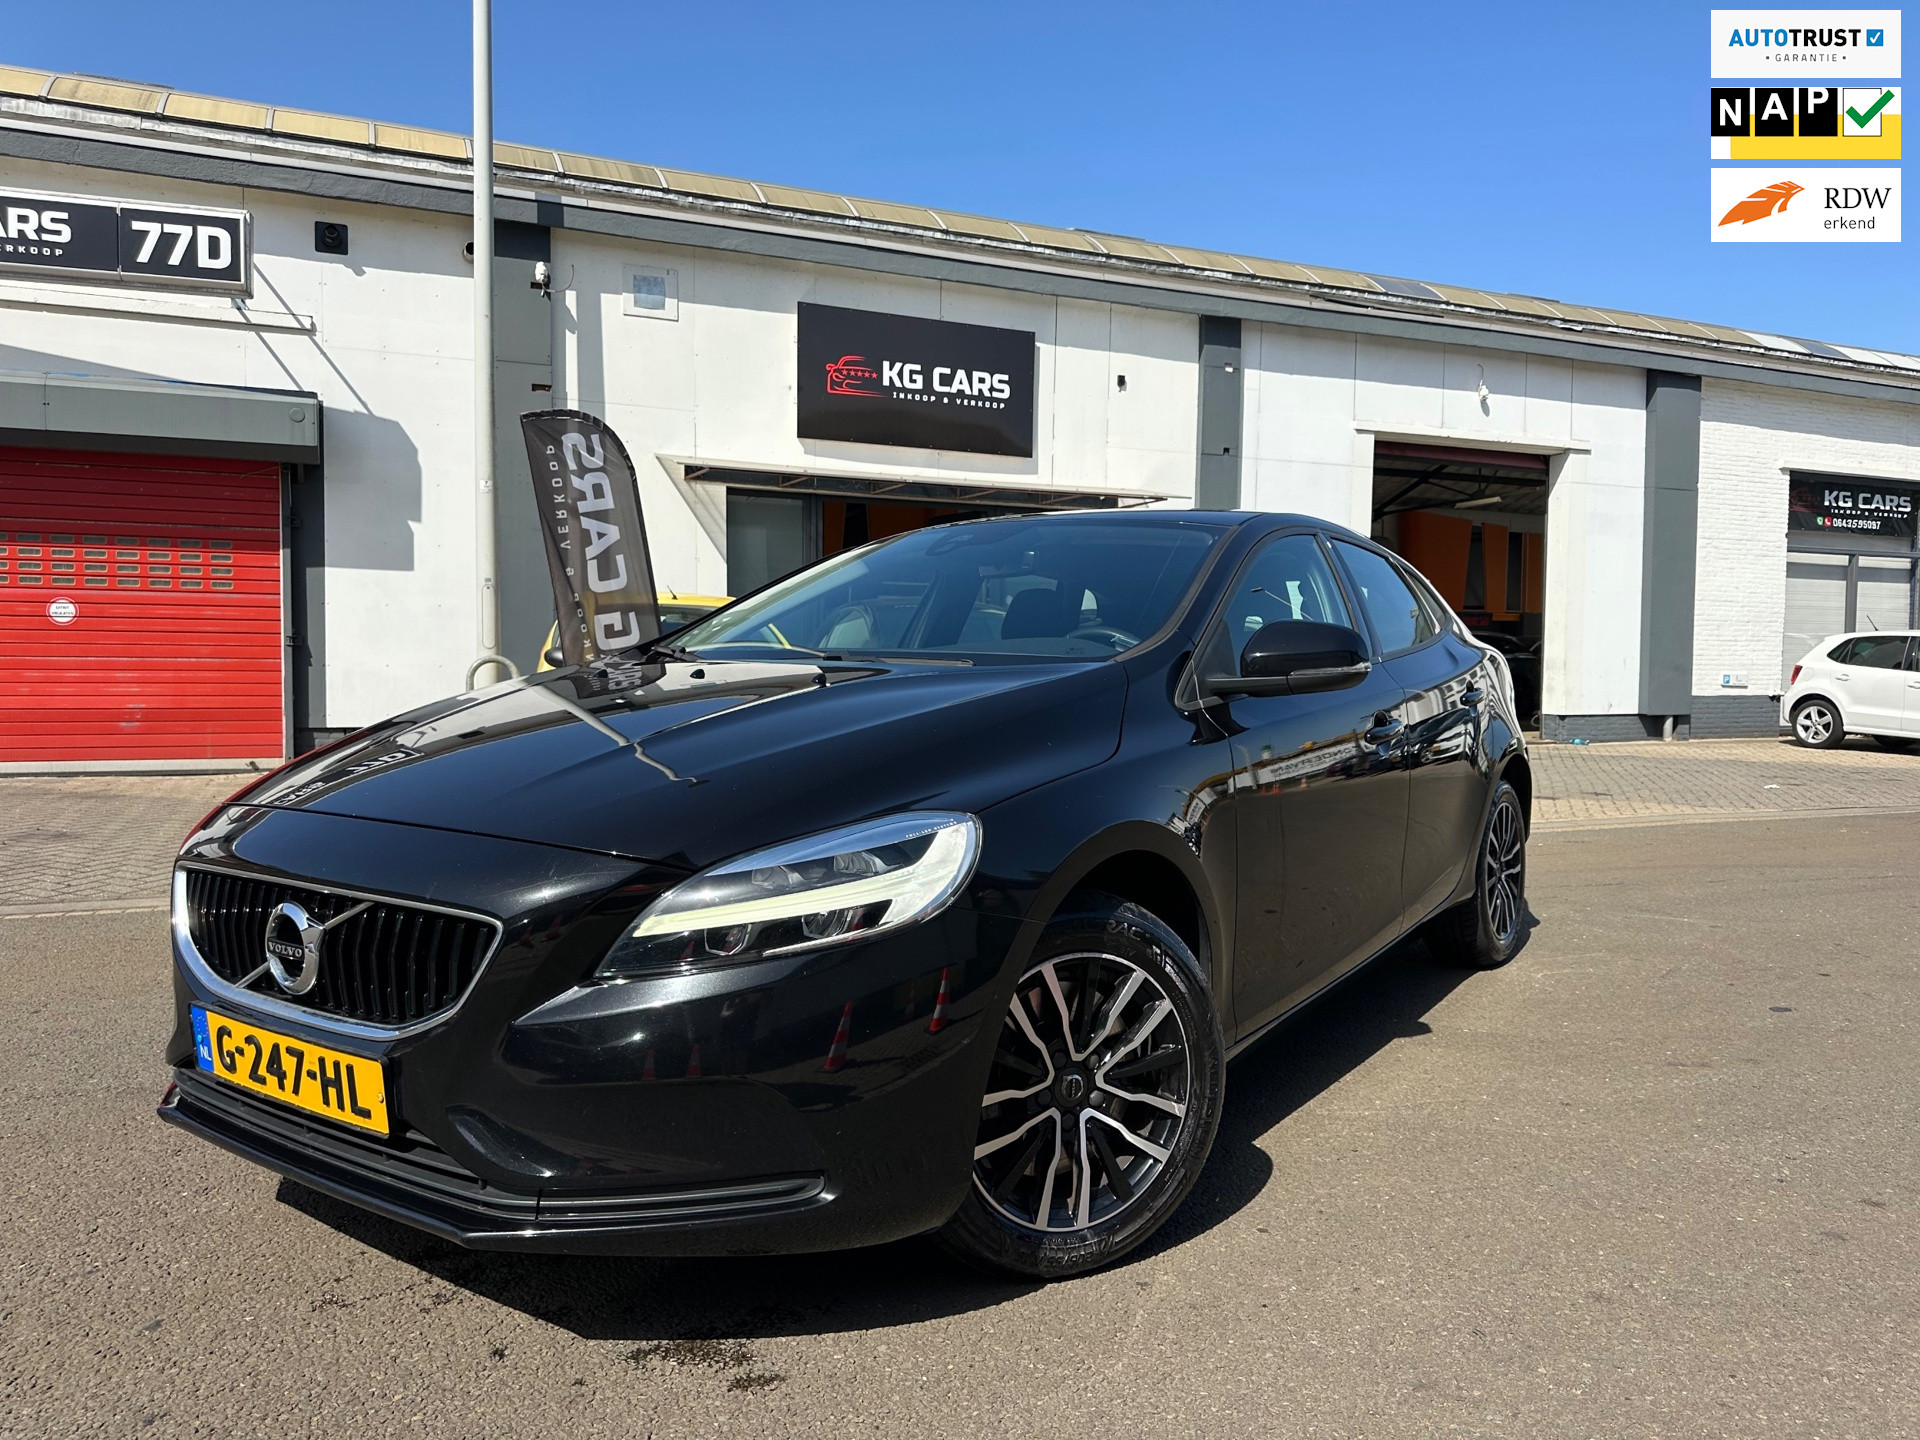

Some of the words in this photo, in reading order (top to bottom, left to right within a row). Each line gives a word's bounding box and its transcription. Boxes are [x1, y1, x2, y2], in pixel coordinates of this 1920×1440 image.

[0, 206, 72, 243] RS
[0, 244, 63, 257] RKOOP
[131, 220, 232, 269] 77D
[882, 360, 924, 390] KG
[932, 366, 1011, 399] CARS
[892, 391, 936, 402] INKOOP
[956, 398, 1005, 409] VERKOOP
[1823, 489, 1853, 508] KG
[1858, 493, 1912, 512] CARS
[268, 941, 302, 957] VOLVO
[200, 1044, 211, 1061] NL
[216, 1025, 372, 1120] G-247-HL
